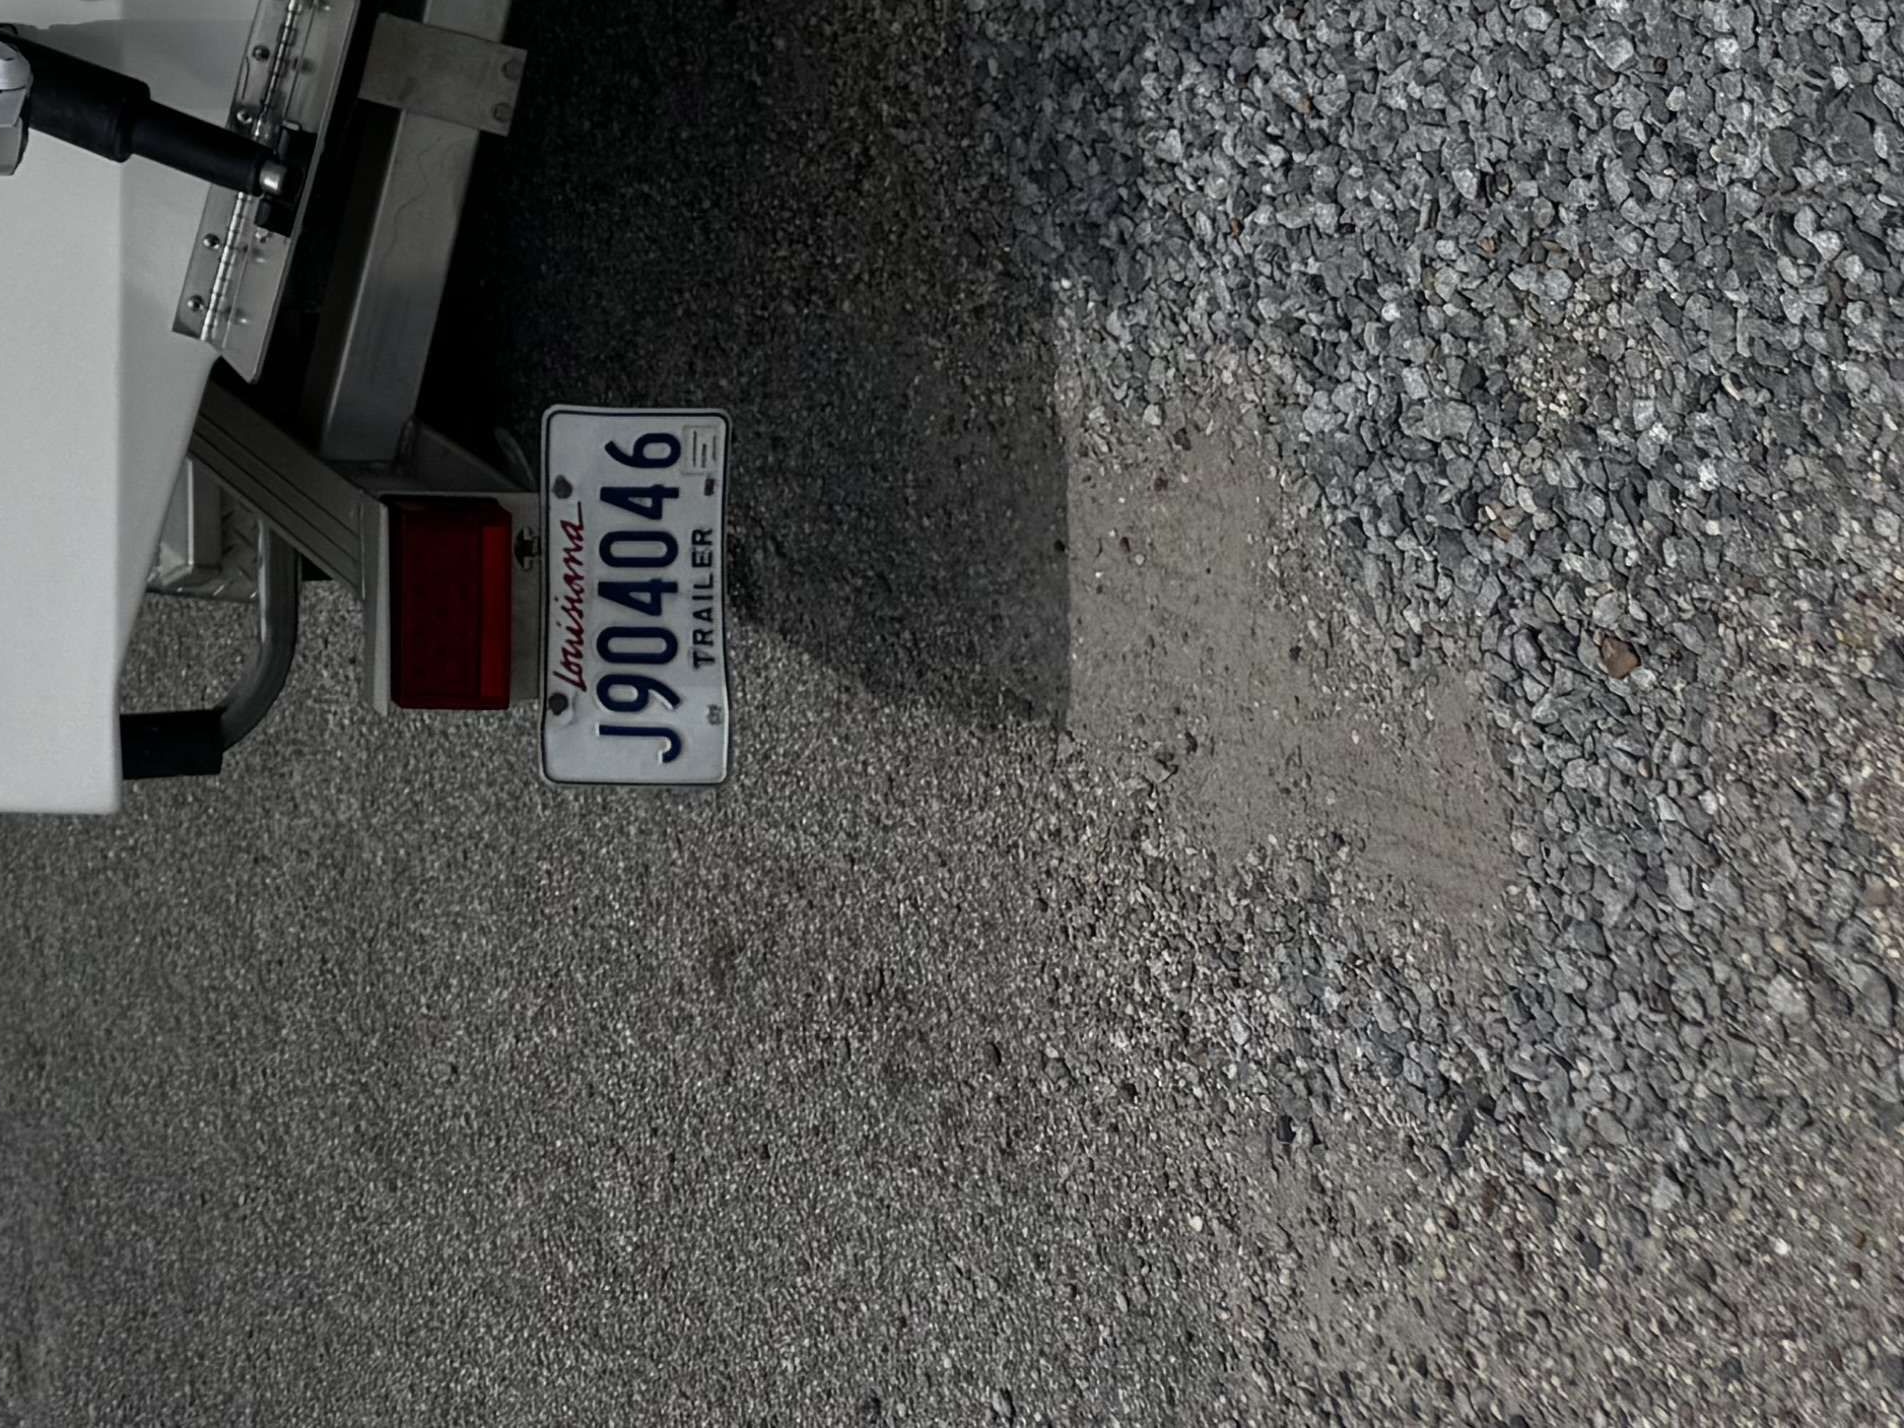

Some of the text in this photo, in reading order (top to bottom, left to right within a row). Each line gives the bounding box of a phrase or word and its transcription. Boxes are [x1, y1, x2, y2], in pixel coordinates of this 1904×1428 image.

[552, 501, 587, 693] Louisiana
[594, 431, 681, 764] J904046
[690, 527, 717, 669] TRAILER
